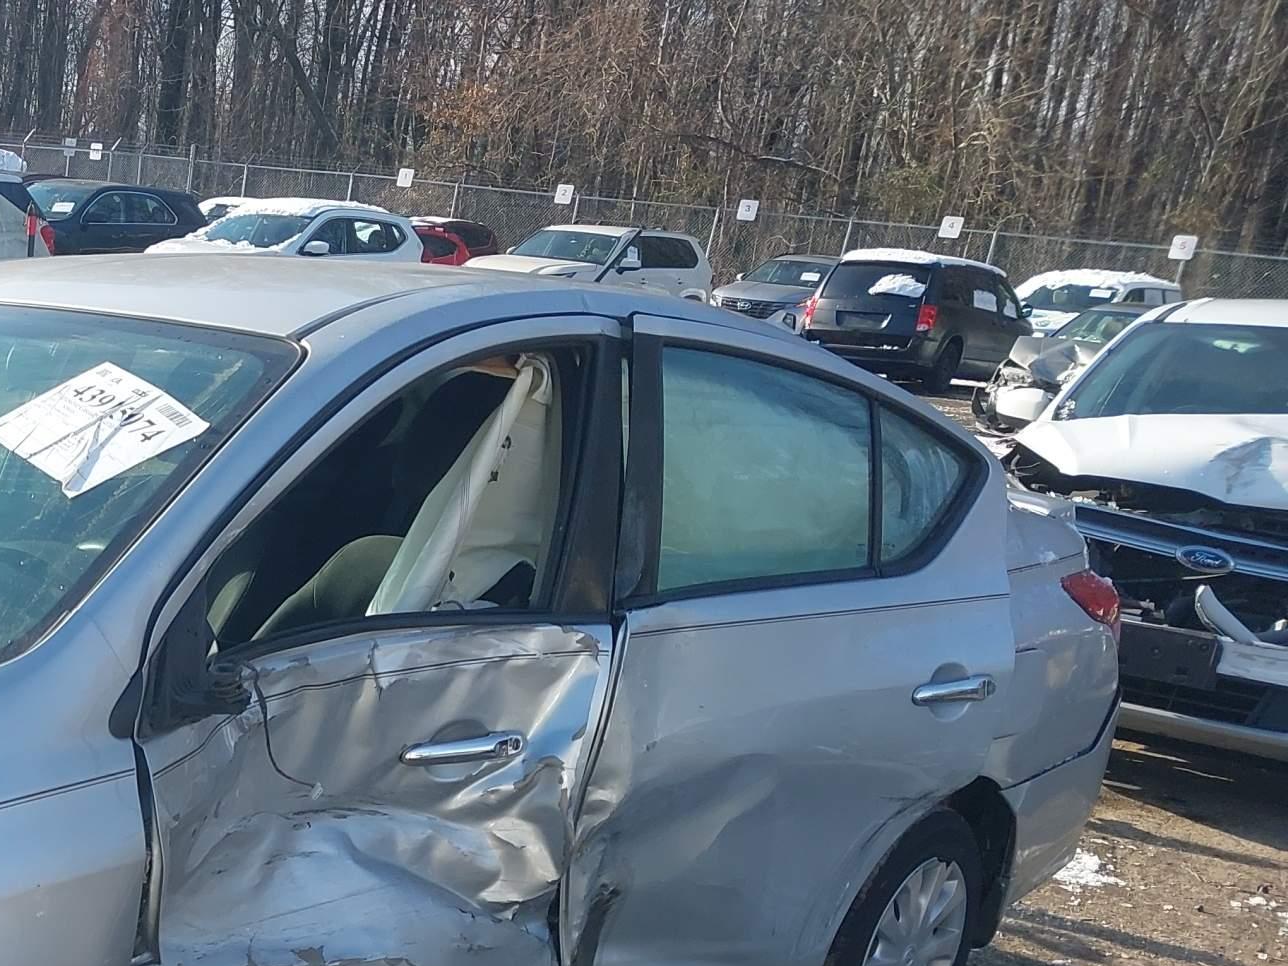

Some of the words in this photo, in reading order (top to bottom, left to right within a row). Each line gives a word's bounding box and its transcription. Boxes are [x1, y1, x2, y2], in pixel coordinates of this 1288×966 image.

[560, 189, 568, 197] 2
[744, 204, 752, 213] 3
[948, 221, 956, 229] 4
[1178, 240, 1187, 250] 5
[1190, 551, 1224, 568] Ford
